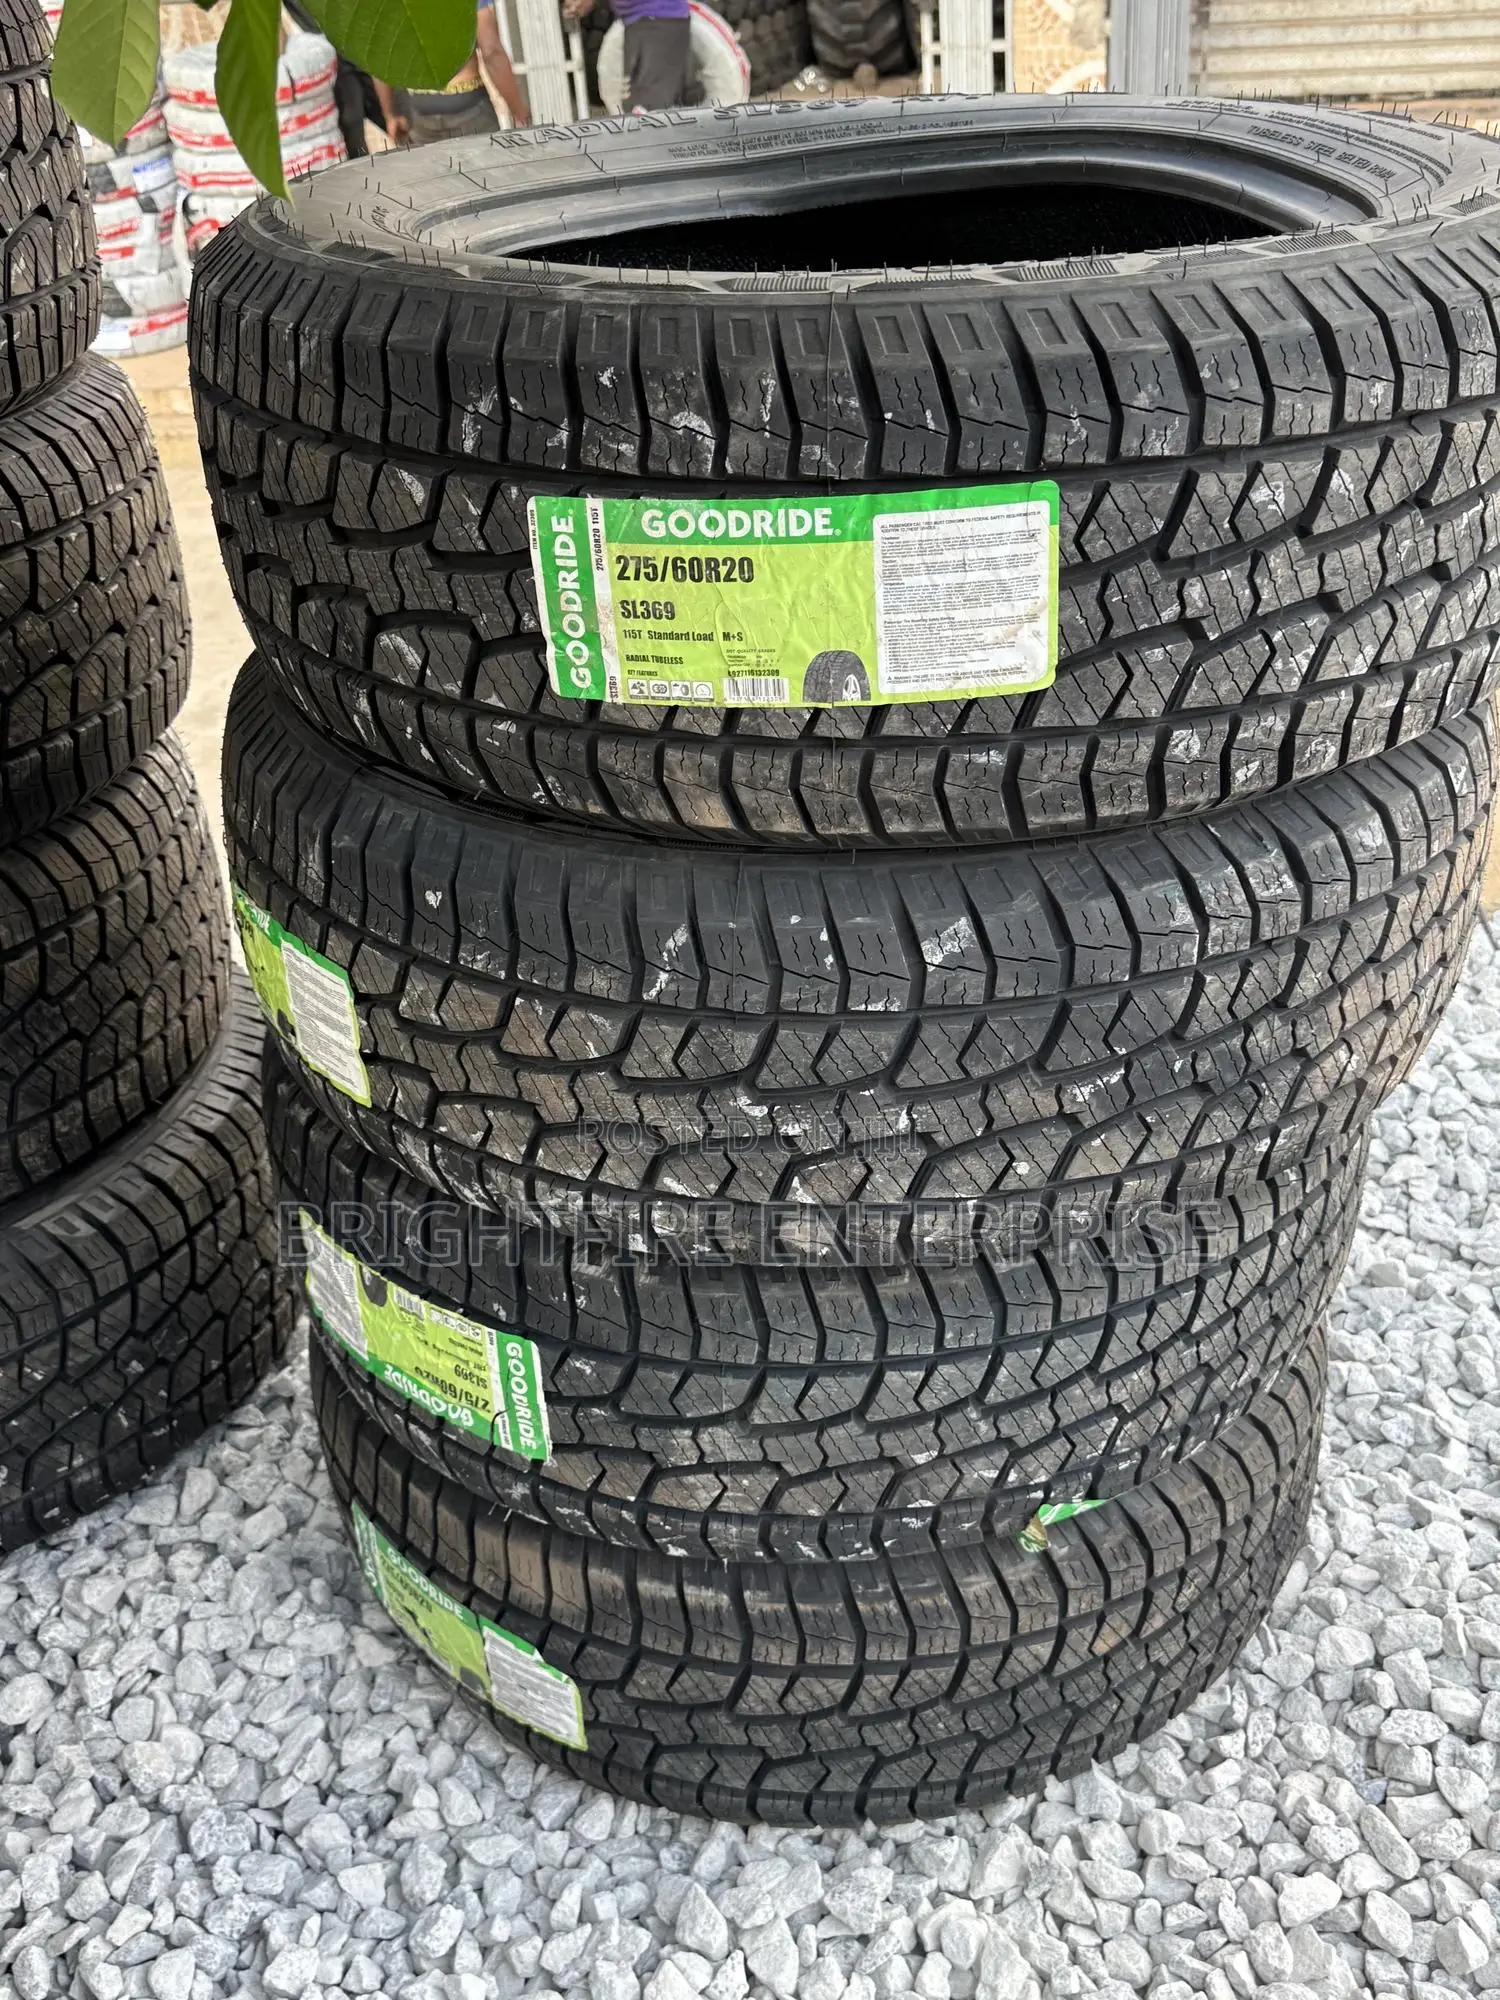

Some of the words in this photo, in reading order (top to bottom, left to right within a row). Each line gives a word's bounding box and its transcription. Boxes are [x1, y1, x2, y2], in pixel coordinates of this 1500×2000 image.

[491, 112, 698, 149] RADIAL
[592, 527, 604, 572] 275/60R20
[615, 554, 755, 583] 275/60R20
[620, 599, 676, 621] SL369
[623, 629, 643, 640] 115T
[647, 630, 692, 642] Standard
[692, 631, 714, 642] Load
[722, 631, 744, 642] M+S
[626, 654, 650, 663] RADIAL
[651, 655, 684, 665] TUBELESS
[383, 1363, 474, 1427] GOODRIDE
[505, 1341, 537, 1450] GOODRIDE
